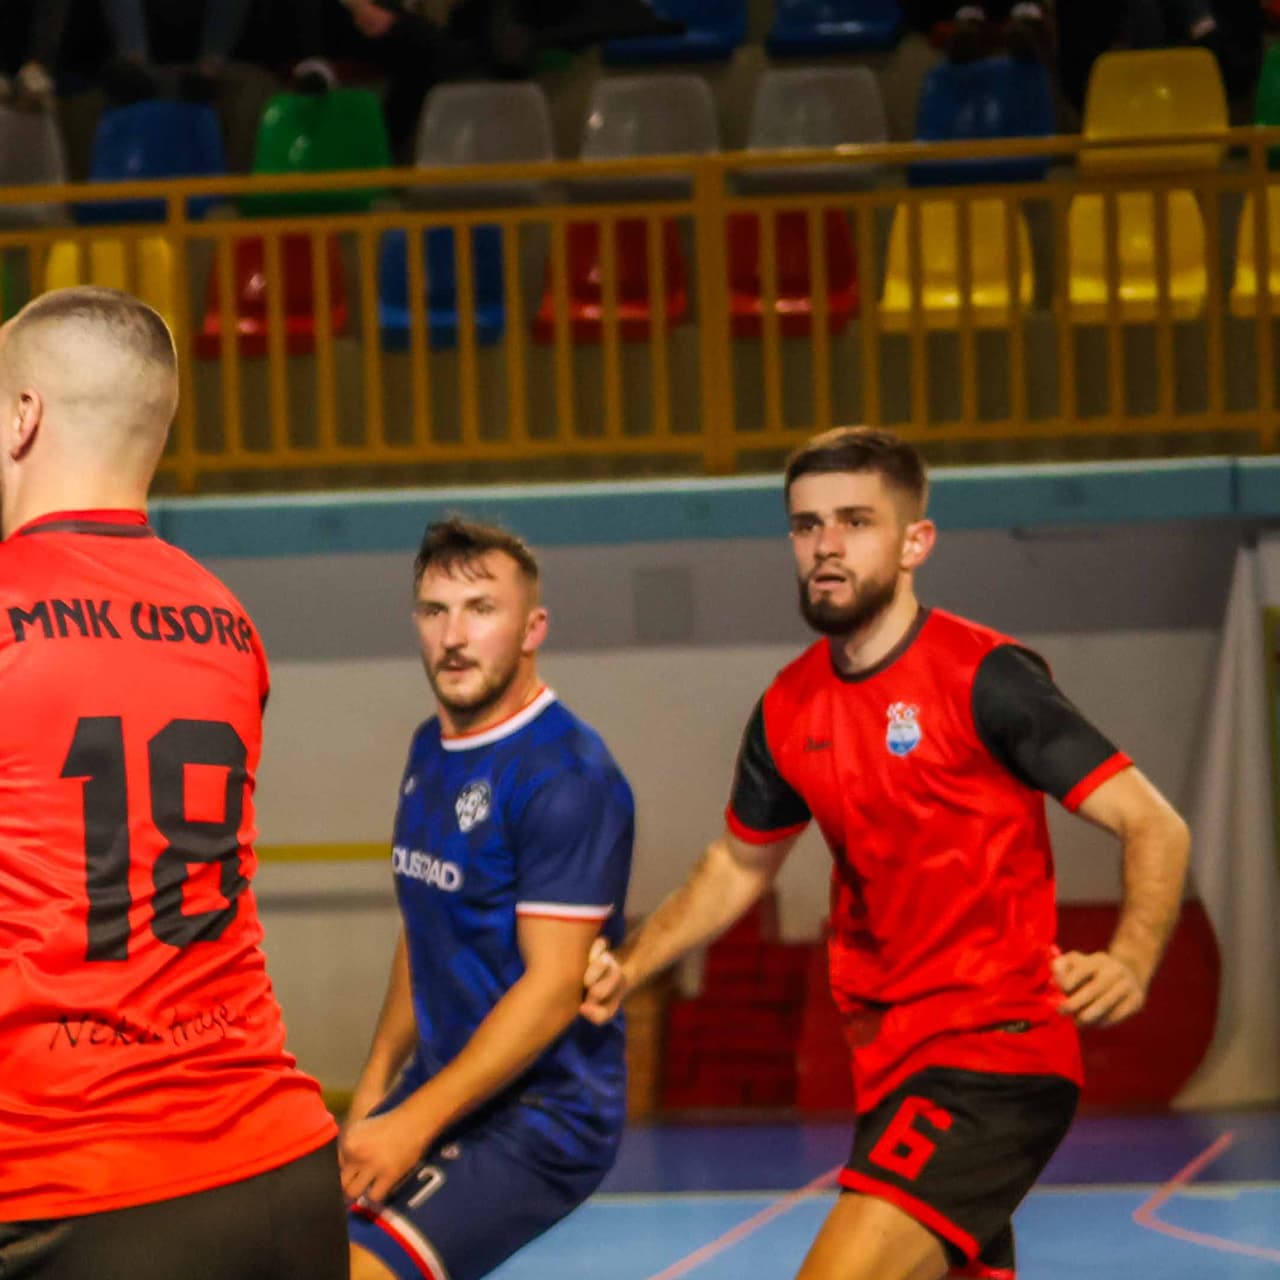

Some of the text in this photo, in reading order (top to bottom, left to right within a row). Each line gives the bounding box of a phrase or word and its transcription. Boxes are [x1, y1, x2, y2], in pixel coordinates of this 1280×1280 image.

[7, 599, 122, 643] MNK
[59, 716, 249, 962] 18
[868, 1096, 953, 1181] 6
